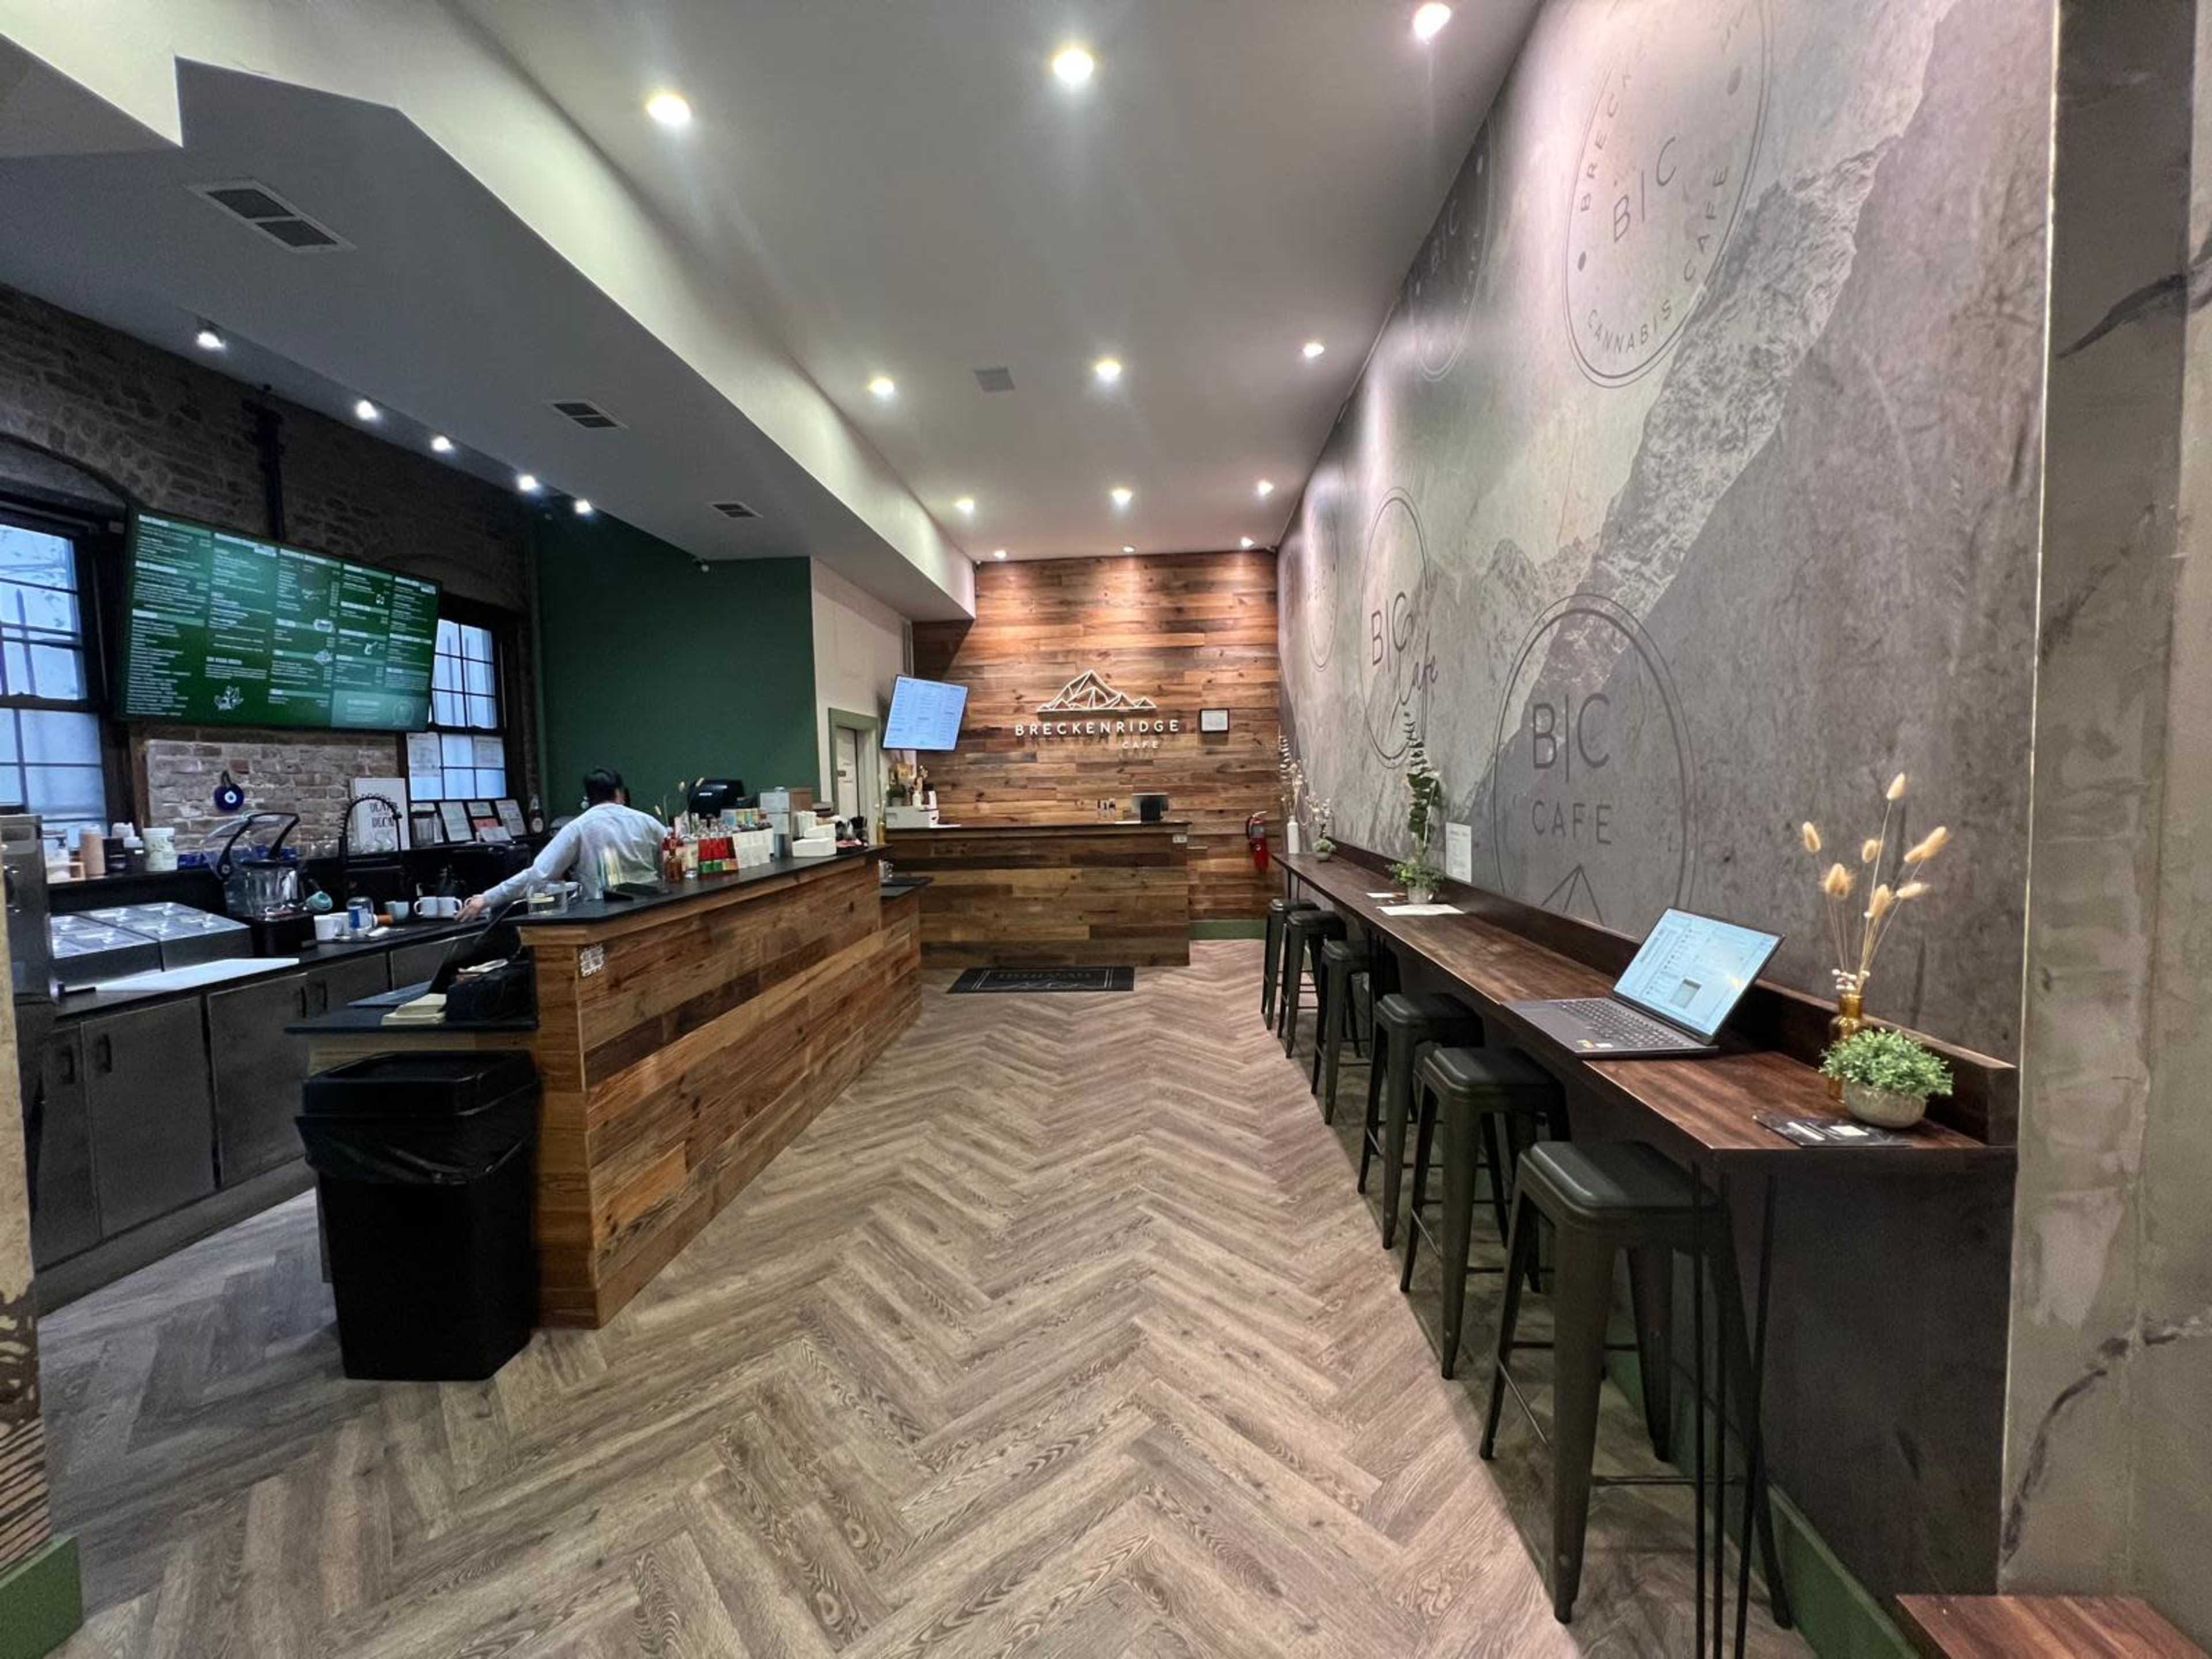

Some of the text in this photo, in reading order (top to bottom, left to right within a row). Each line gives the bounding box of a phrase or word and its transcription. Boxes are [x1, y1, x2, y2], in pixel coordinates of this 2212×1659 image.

[1587, 165, 1730, 354] CANNABIS CAFE
[1015, 719, 1179, 736] BRECKENRIDGE
[1122, 740, 1159, 749] CAFE
[1532, 801, 1612, 846] CAFE
